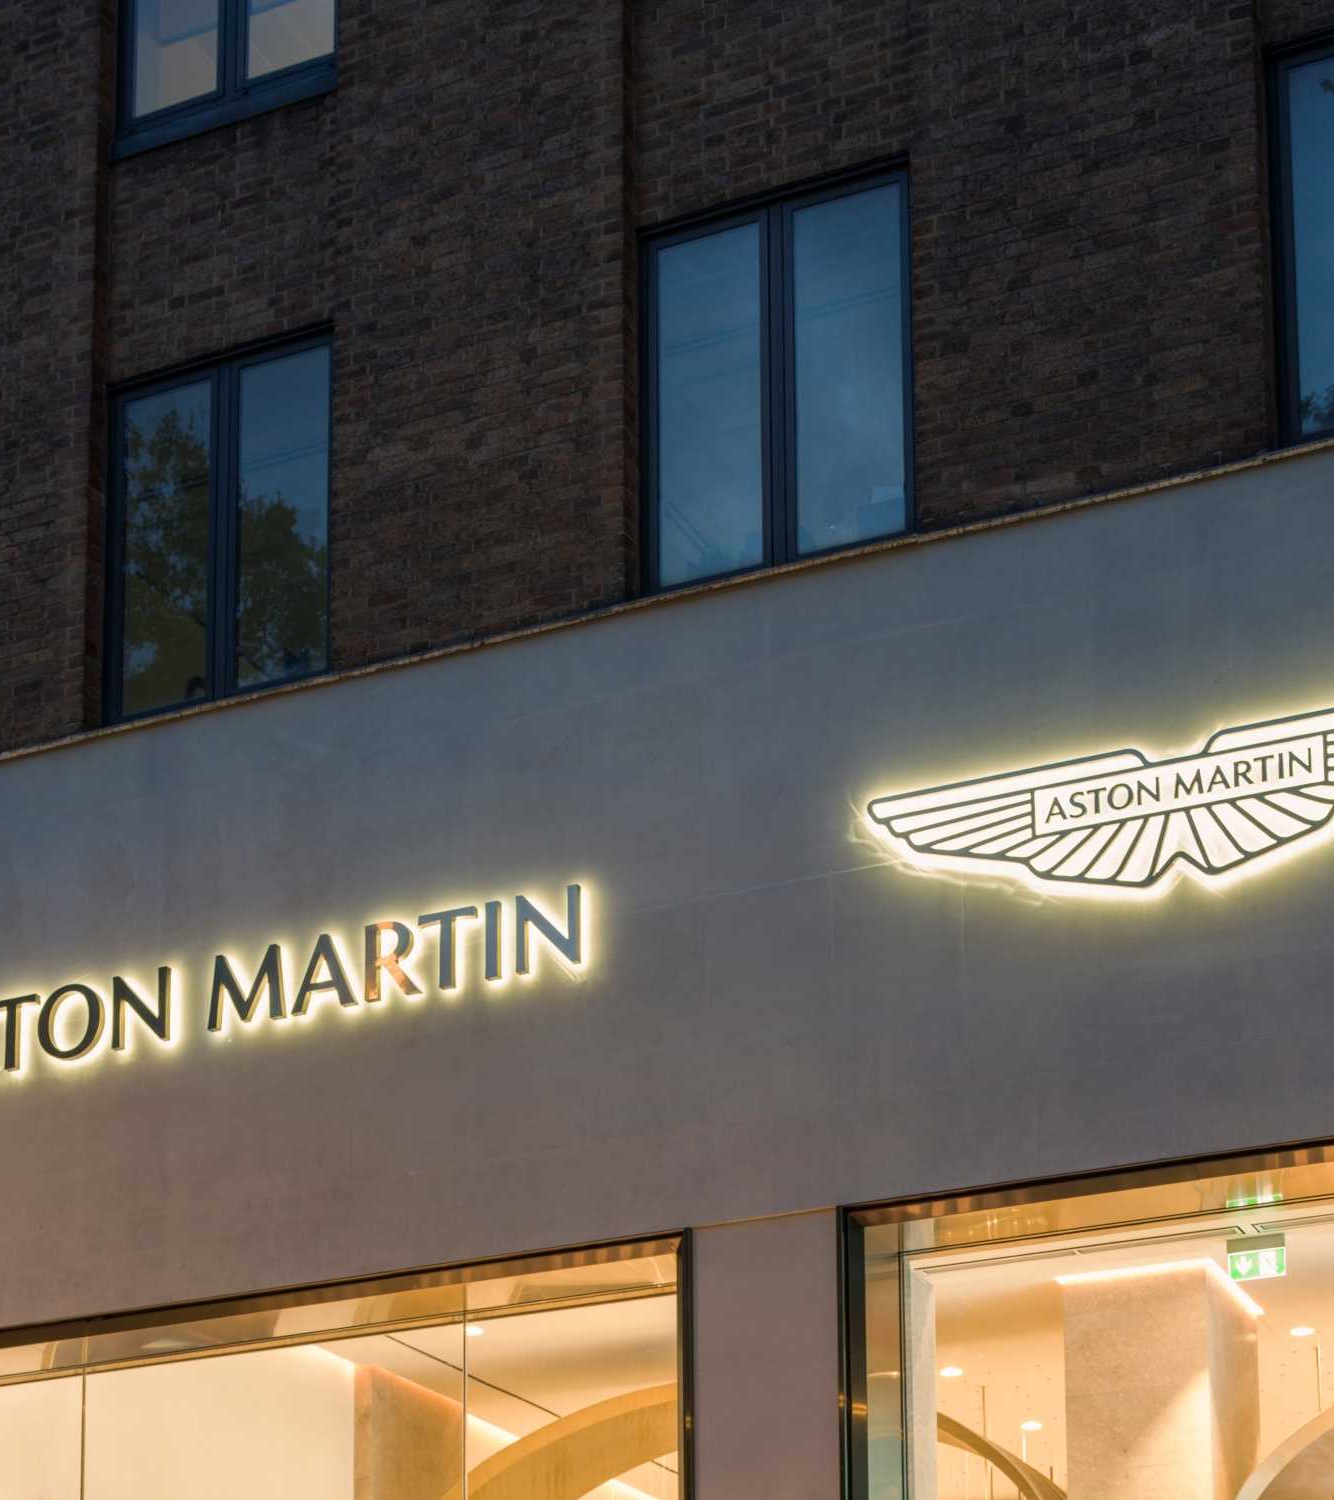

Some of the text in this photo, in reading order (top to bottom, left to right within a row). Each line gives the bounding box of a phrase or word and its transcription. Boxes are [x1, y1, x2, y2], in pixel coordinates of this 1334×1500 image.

[1045, 748, 1313, 824] ASTON MARTIN
[208, 884, 581, 1032] MARTIN
